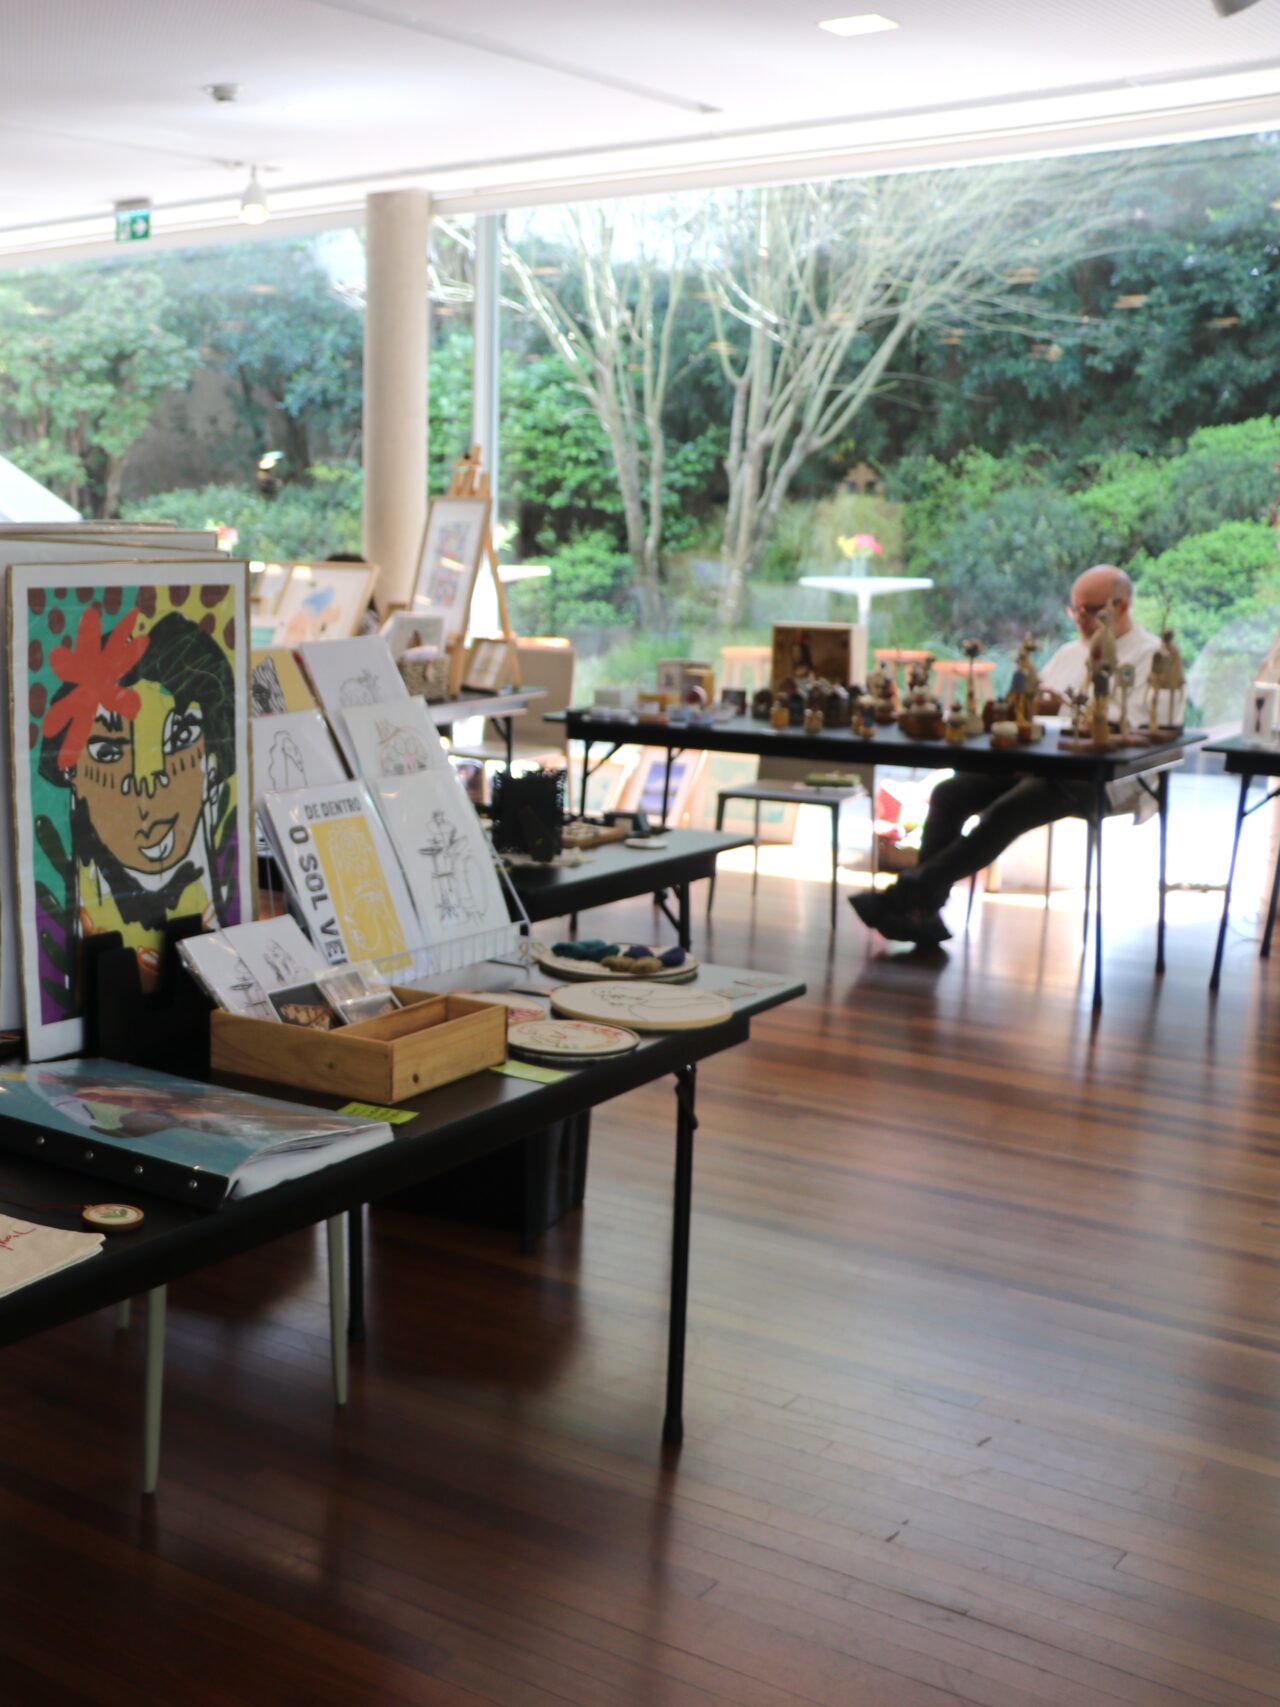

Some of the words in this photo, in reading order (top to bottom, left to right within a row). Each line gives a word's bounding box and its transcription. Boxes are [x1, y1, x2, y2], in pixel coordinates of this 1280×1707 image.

[304, 804, 321, 820] DE
[321, 797, 362, 817] DENTRO
[289, 825, 309, 844] O
[299, 854, 328, 910] SOL
[320, 916, 348, 966] VE
